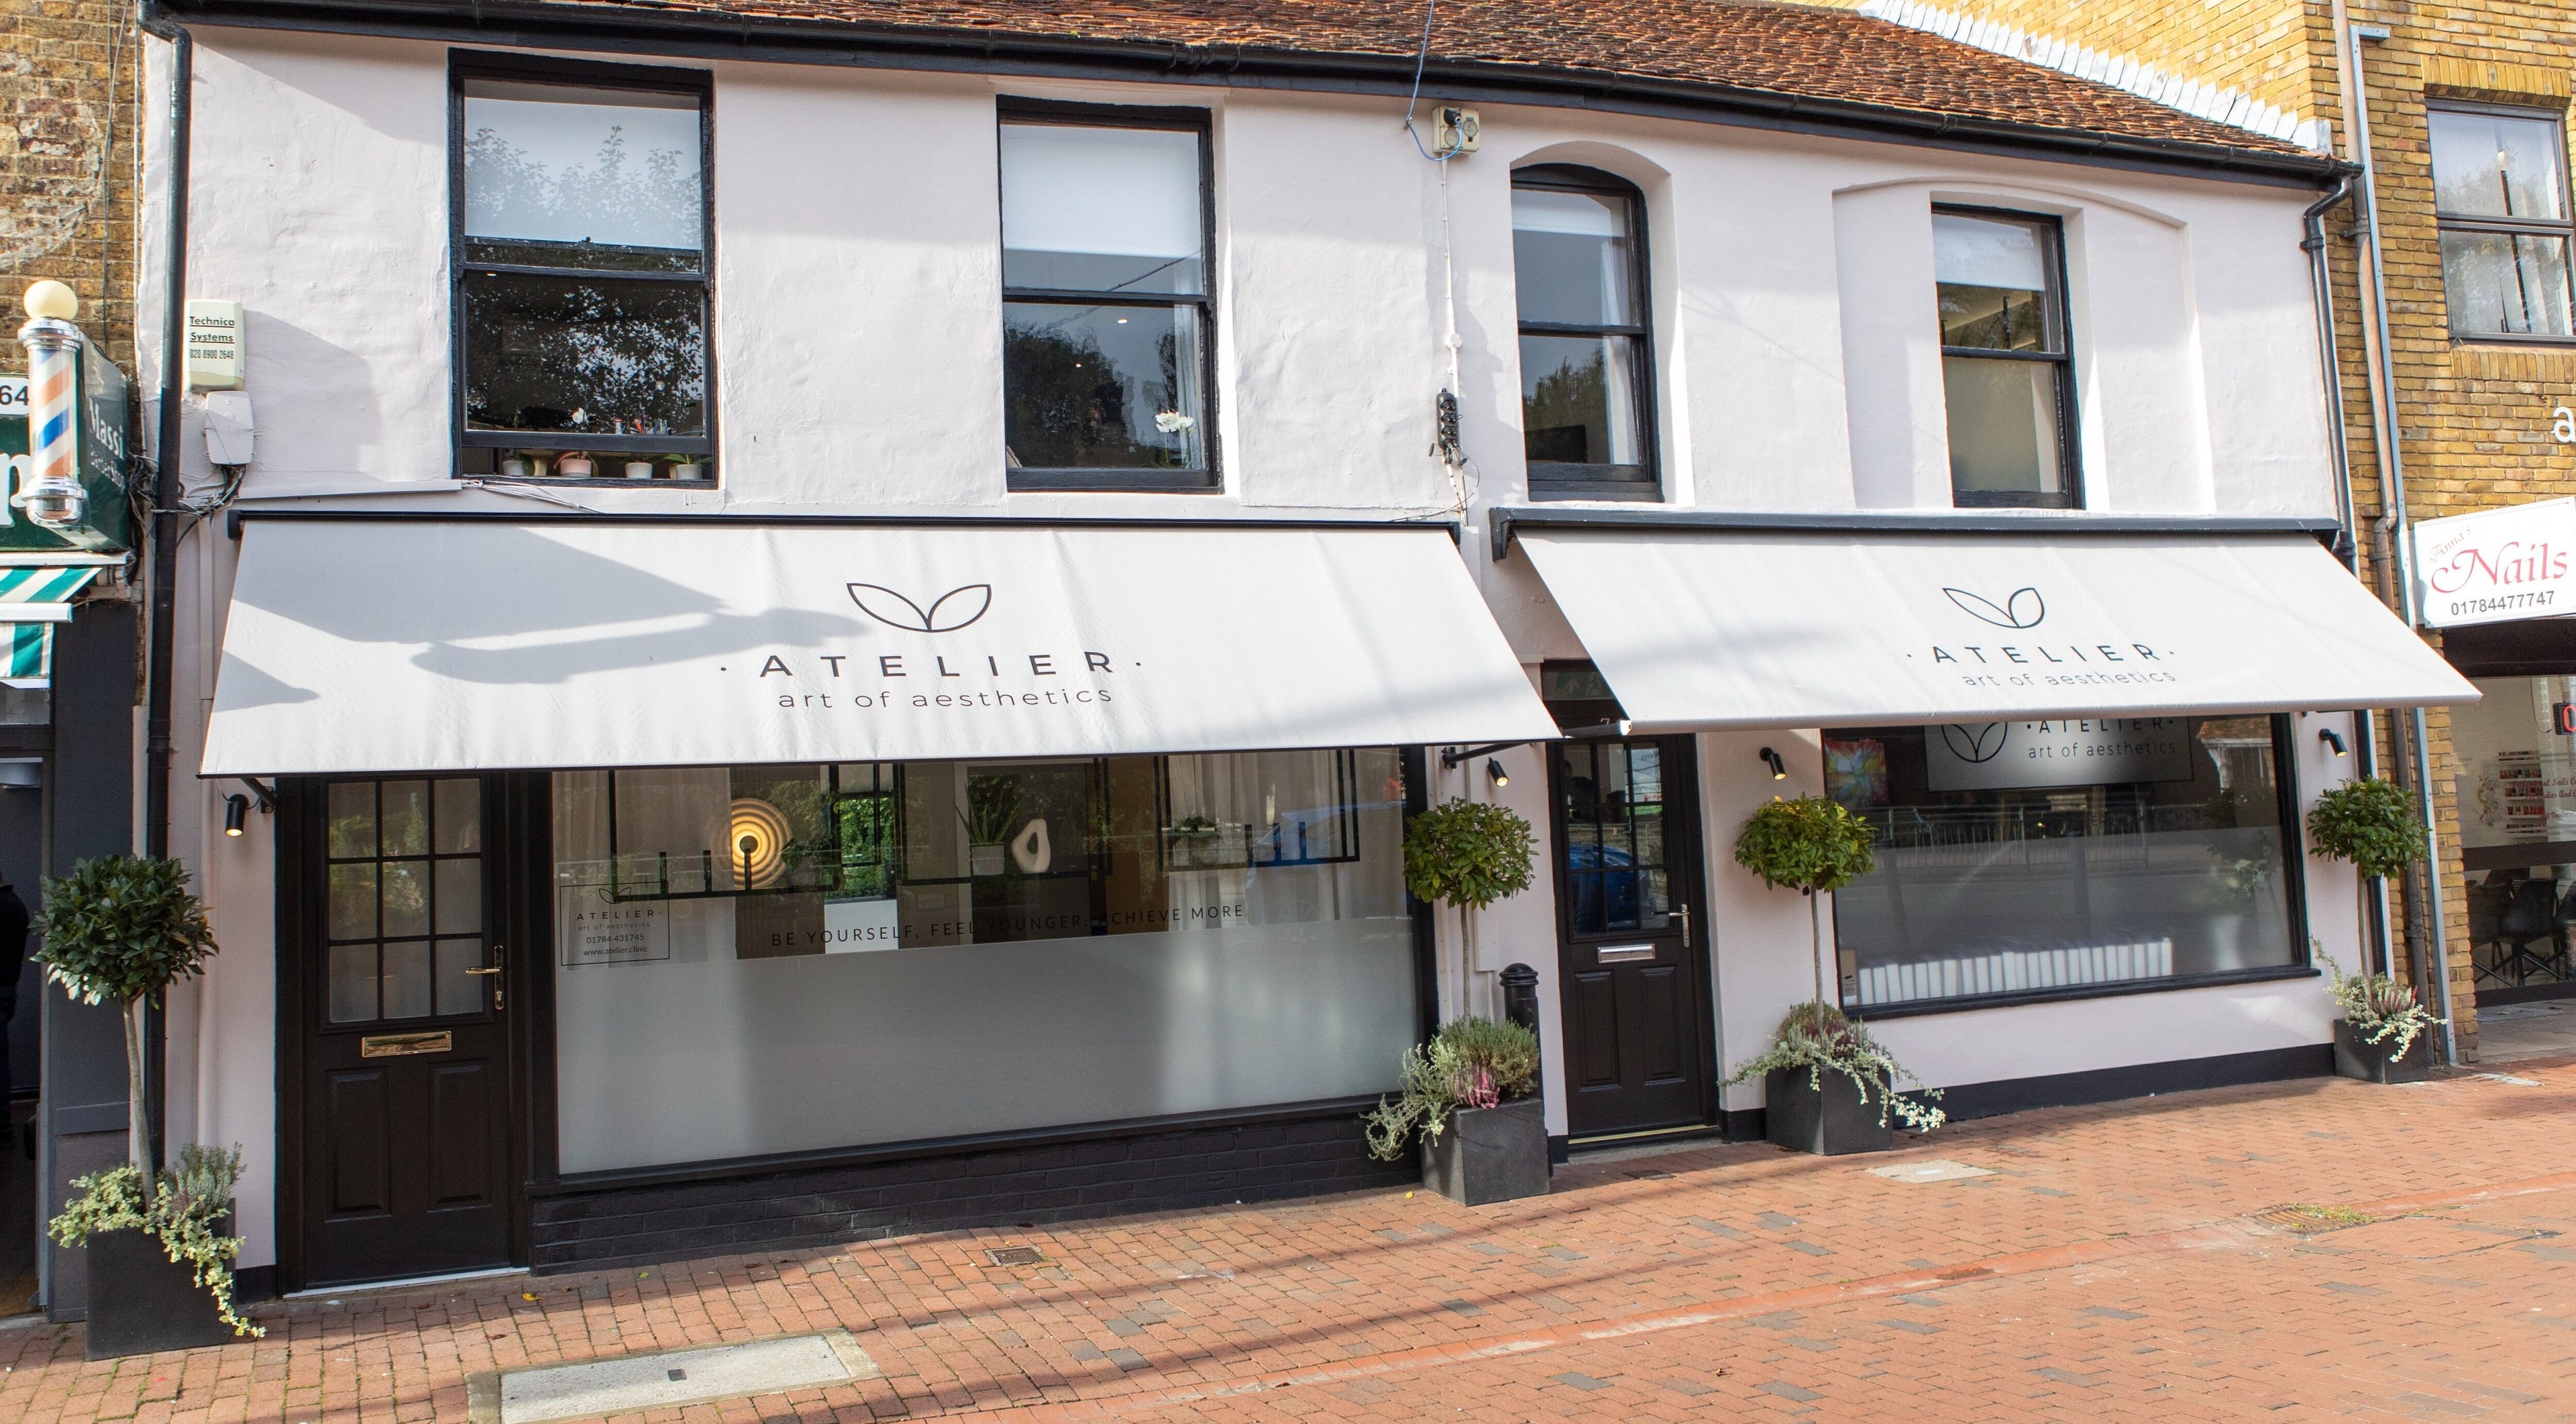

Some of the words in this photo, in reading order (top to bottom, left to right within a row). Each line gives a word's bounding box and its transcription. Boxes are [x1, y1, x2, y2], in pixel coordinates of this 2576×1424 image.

[189, 316, 235, 326] Technica
[191, 332, 233, 343] Systems
[190, 349, 201, 359] 020
[2431, 541, 2568, 594] Nails
[2451, 590, 2555, 616] 01784477747
[1932, 643, 2161, 664] ATELIER
[759, 651, 1114, 678] ATELIER
[1962, 674, 2002, 687] art
[2009, 673, 2035, 687] of
[2045, 671, 2176, 686] aesthetics
[778, 693, 834, 709] art
[854, 690, 891, 708] of
[912, 687, 1113, 708] aesthetics
[2029, 745, 2053, 759] art
[2061, 742, 2078, 757] of
[2086, 741, 2176, 757] aesthetics
[576, 910, 655, 921] ATELIER
[606, 921, 650, 930] aesthetics
[771, 932, 796, 946] BE
[806, 924, 920, 945] YOURSELF,
[930, 921, 976, 937] FEEL
[1097, 908, 1181, 926] ACHIEVE
[1191, 904, 1244, 920] MORE
[586, 936, 612, 944] 01784
[614, 934, 645, 942] 431745
[583, 945, 649, 956] www.atelier.clinic
